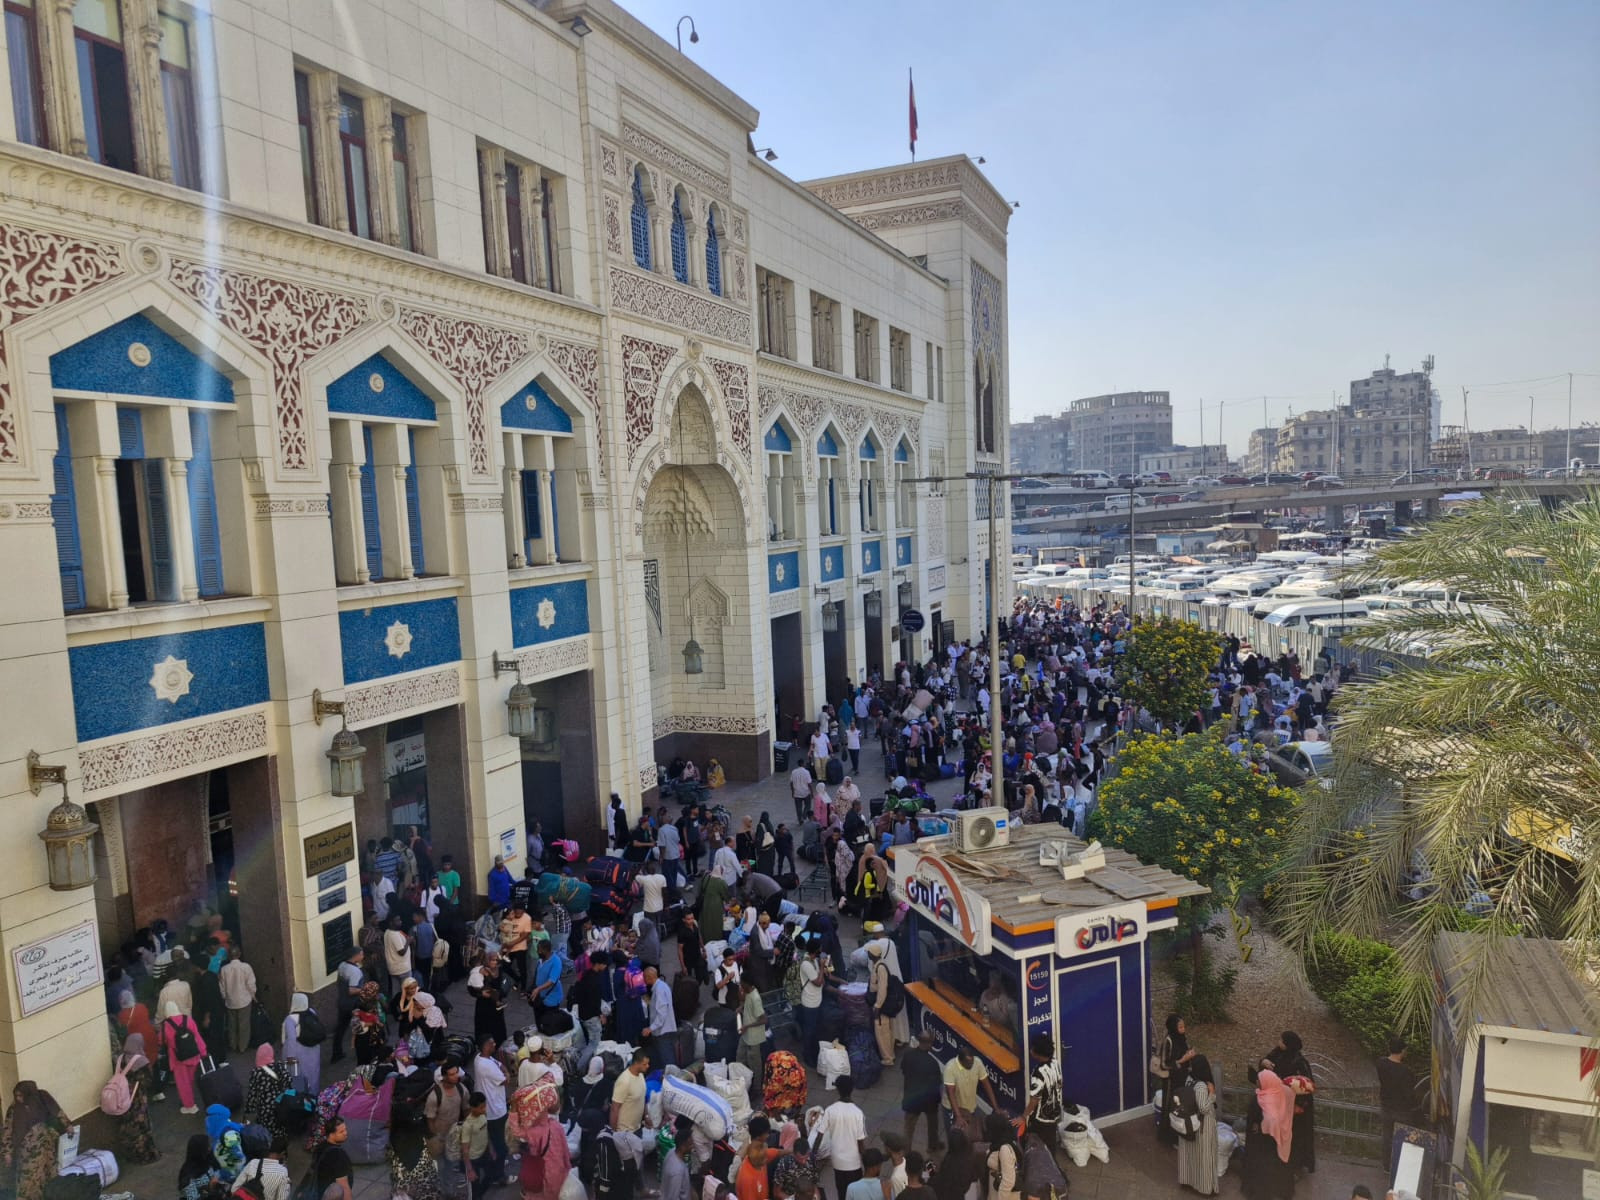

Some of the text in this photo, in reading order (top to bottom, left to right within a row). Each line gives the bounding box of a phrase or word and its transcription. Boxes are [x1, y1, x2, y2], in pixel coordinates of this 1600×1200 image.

[309, 855, 330, 870] ENTRY
[1029, 970, 1049, 981] 15159
[1033, 994, 1049, 1007] احجز
[1027, 1011, 1053, 1025] تذكرتك
